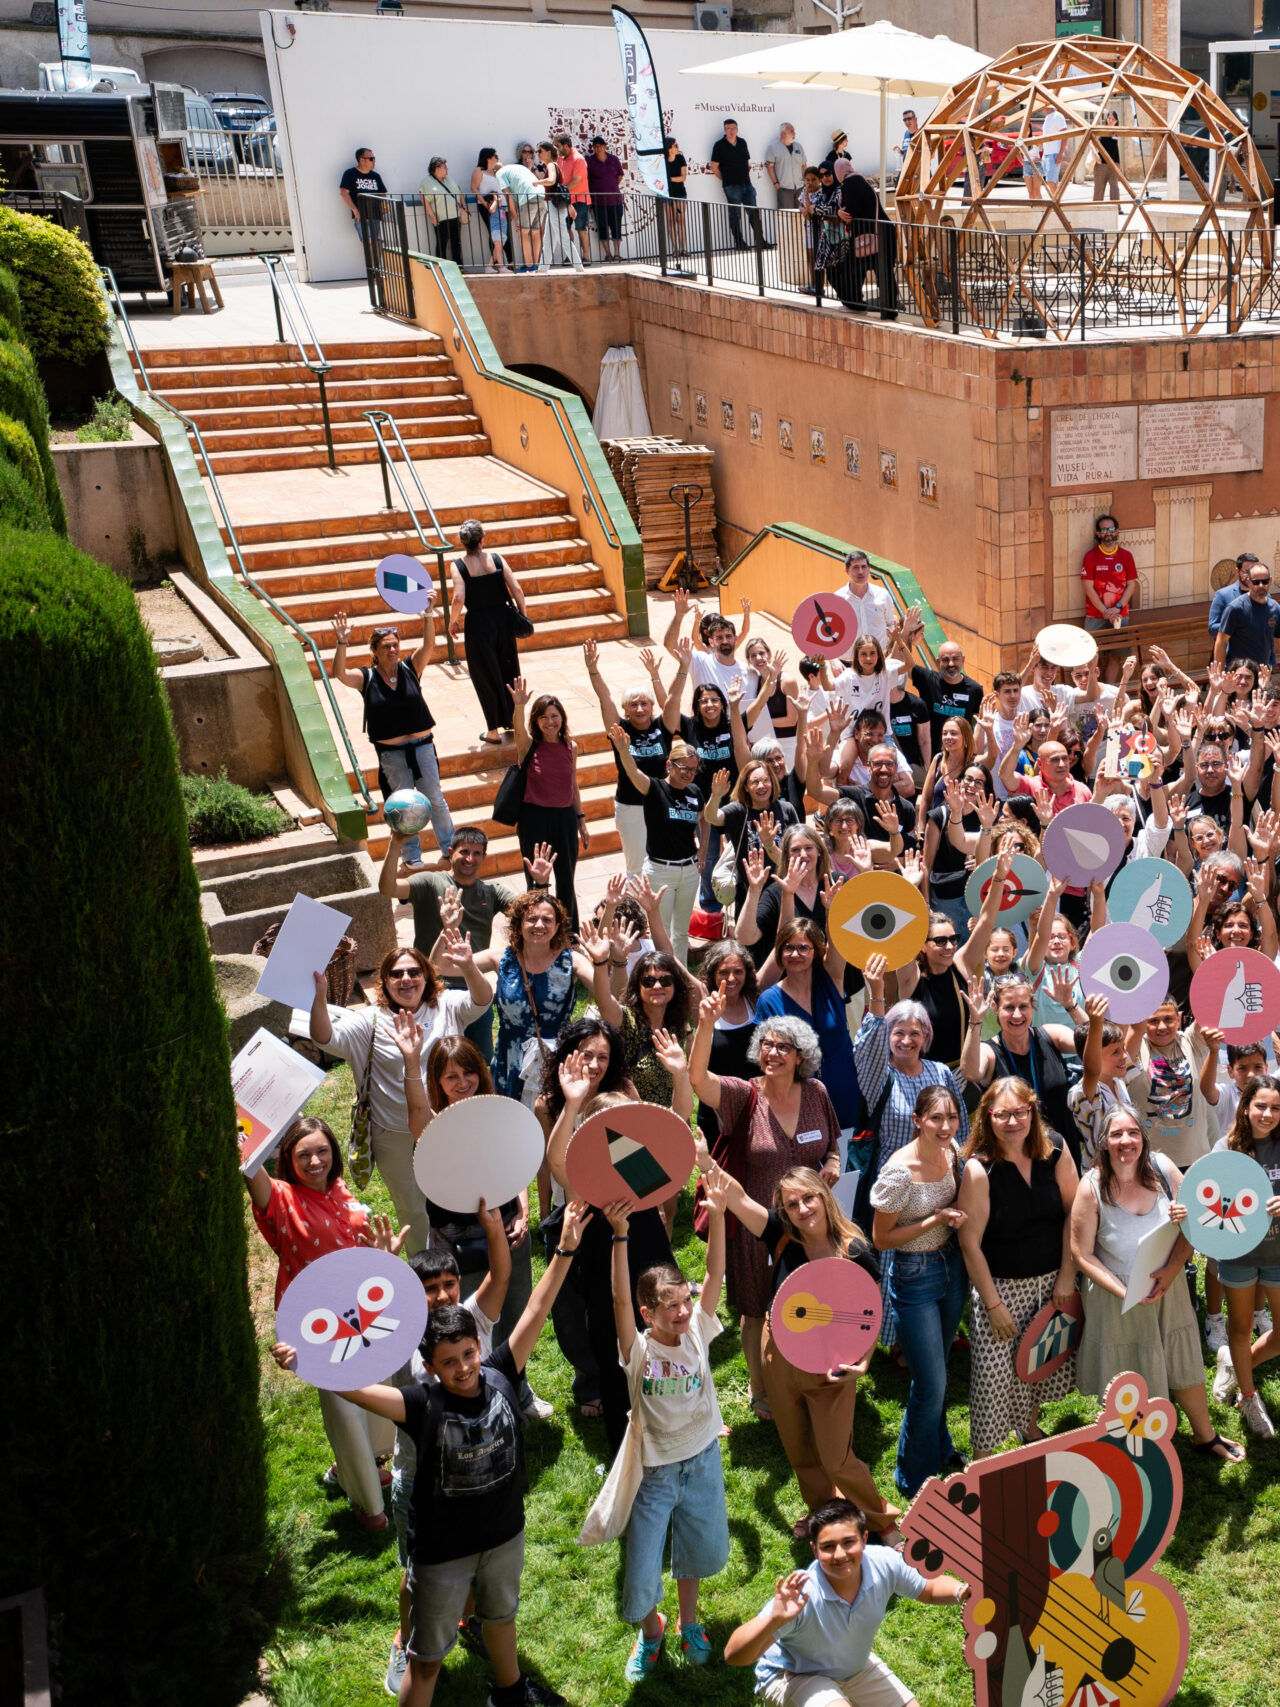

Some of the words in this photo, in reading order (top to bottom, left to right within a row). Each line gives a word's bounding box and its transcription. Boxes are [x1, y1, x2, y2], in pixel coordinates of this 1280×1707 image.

[694, 102, 776, 113] #MuseuVidaRural
[1056, 462, 1087, 473] MUSEU
[1056, 473, 1079, 482] VIDA
[1085, 470, 1113, 481] RURAL
